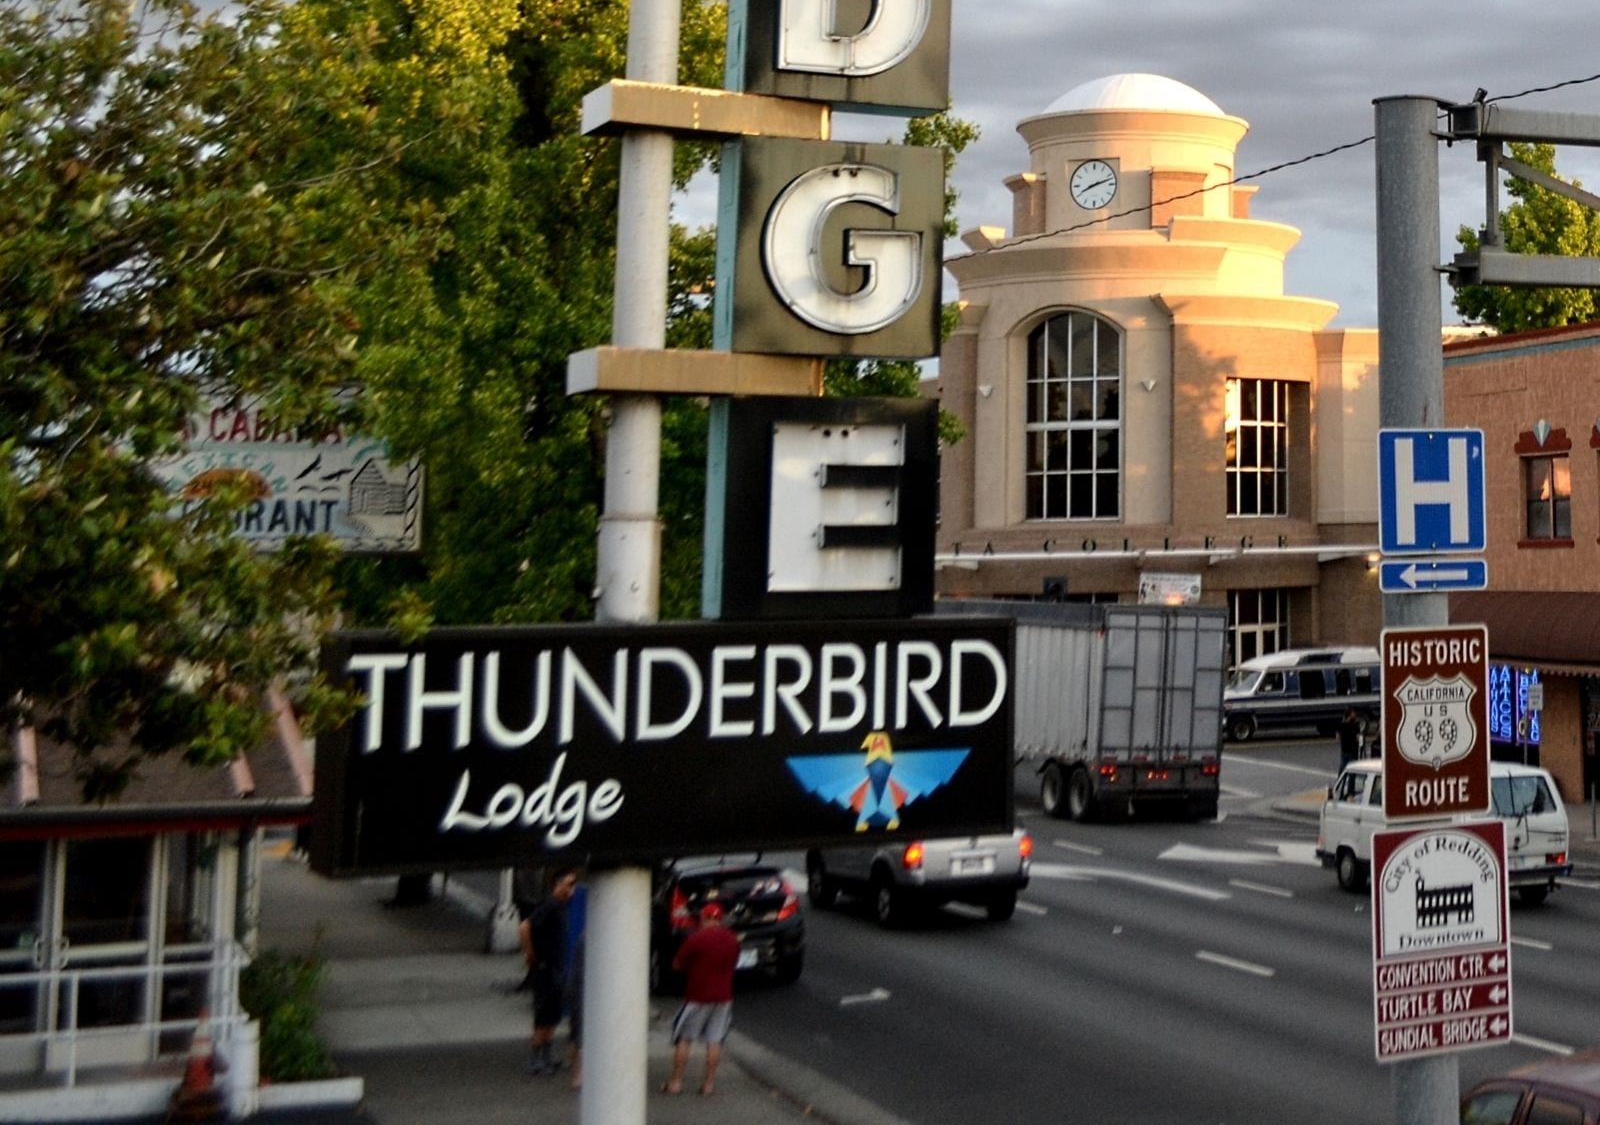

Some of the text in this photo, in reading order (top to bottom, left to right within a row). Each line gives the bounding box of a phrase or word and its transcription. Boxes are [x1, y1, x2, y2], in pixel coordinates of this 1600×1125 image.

[1394, 437, 1470, 546] H
[1043, 535, 1290, 555] COLLEGE
[1389, 637, 1481, 667] HISTORIC
[347, 639, 1008, 753] THUNDERBIRD
[1407, 686, 1466, 703] CALIFORNIA
[1415, 718, 1458, 755] 99
[440, 751, 625, 849] Lodge
[1405, 776, 1470, 807] ROUTE
[1384, 835, 1495, 894] City of Redding
[1399, 928, 1485, 950] Downtown
[1379, 960, 1455, 989] CONVENTION
[1380, 987, 1474, 1021] TURTLE BAY
[1381, 1017, 1489, 1055] SUNDIAL BRIDGE
